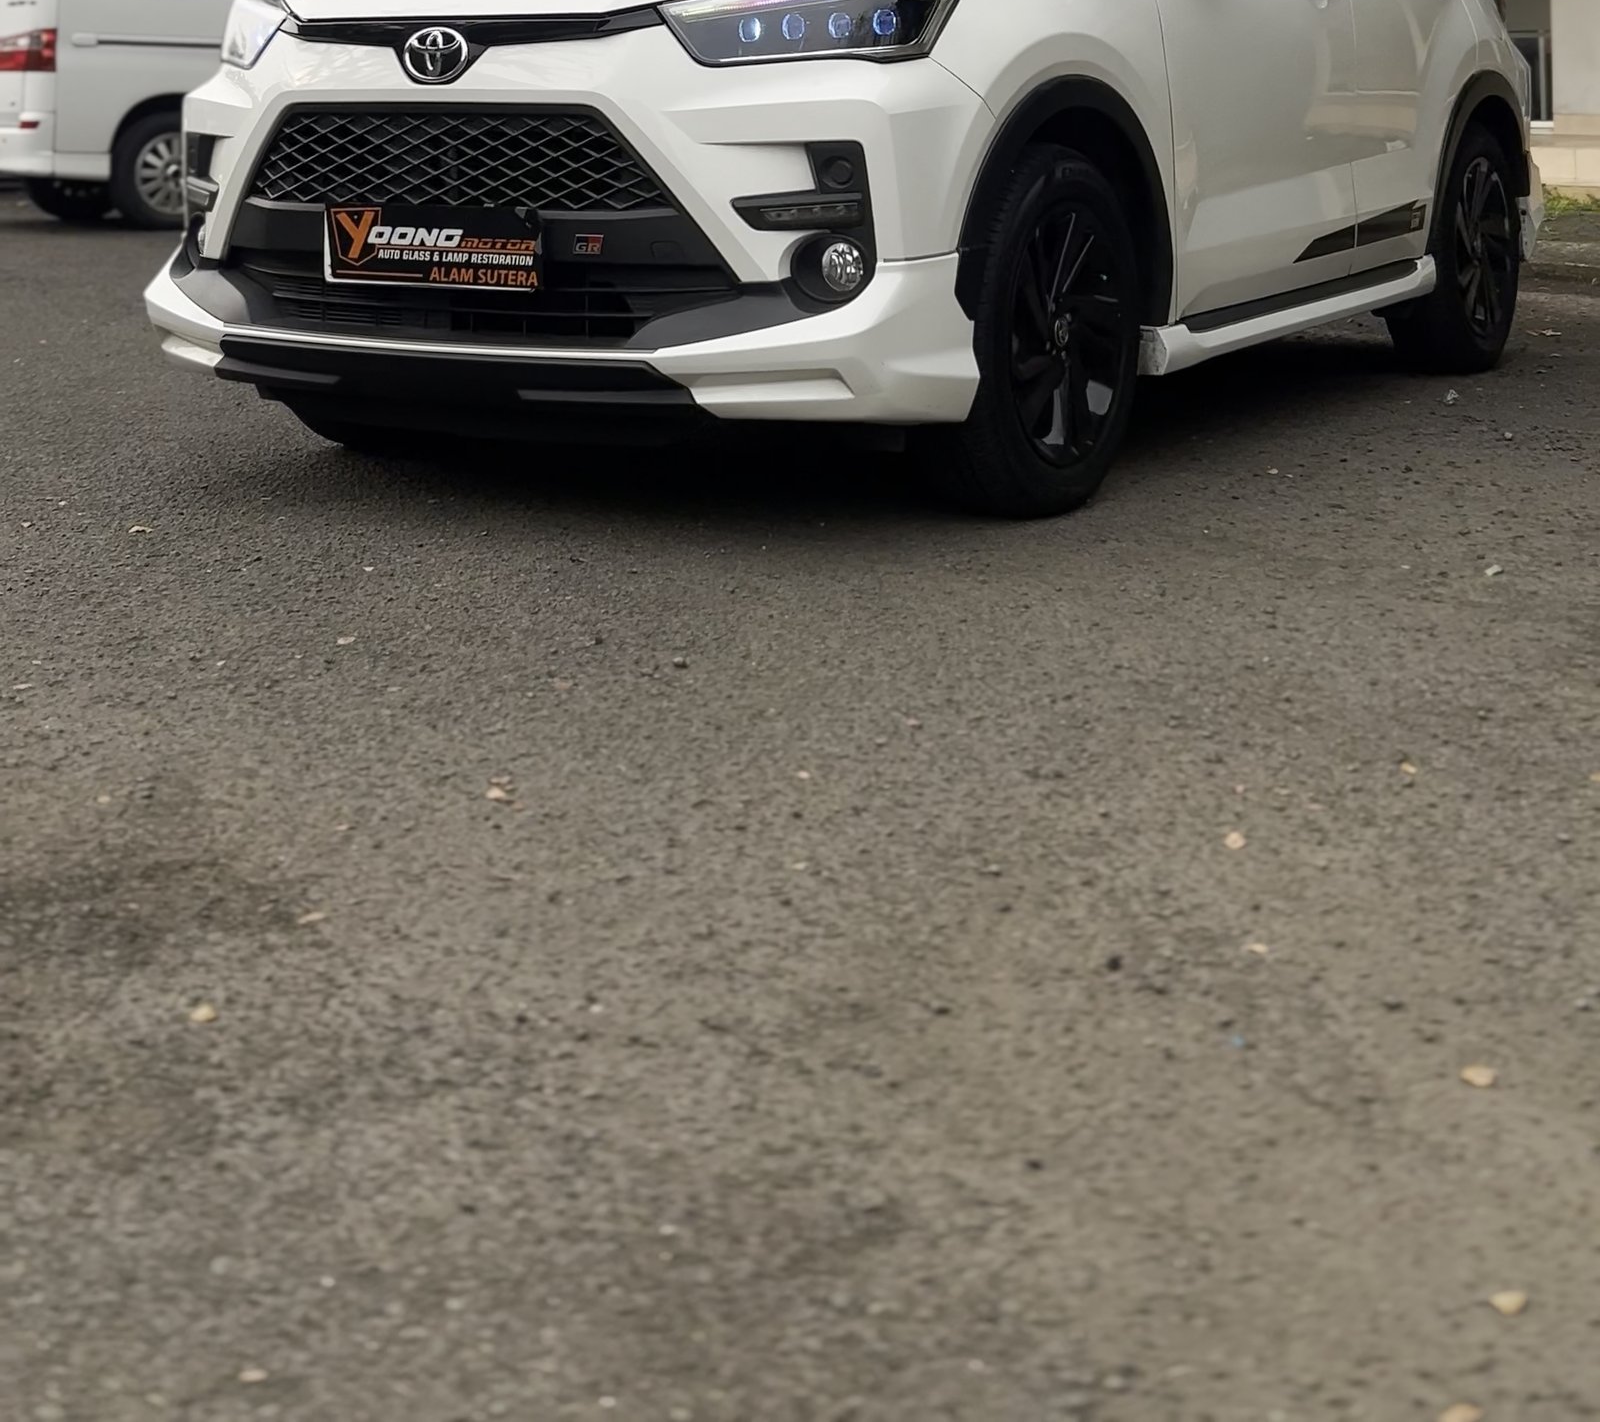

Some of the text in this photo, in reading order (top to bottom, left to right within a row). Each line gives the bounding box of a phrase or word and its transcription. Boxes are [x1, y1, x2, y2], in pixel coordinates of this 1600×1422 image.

[335, 210, 464, 259] YOONG
[377, 248, 534, 267] AUTO GLASS & LAMP RESTORATION
[575, 242, 601, 253] GR
[429, 266, 539, 287] ALAM SUTERA
